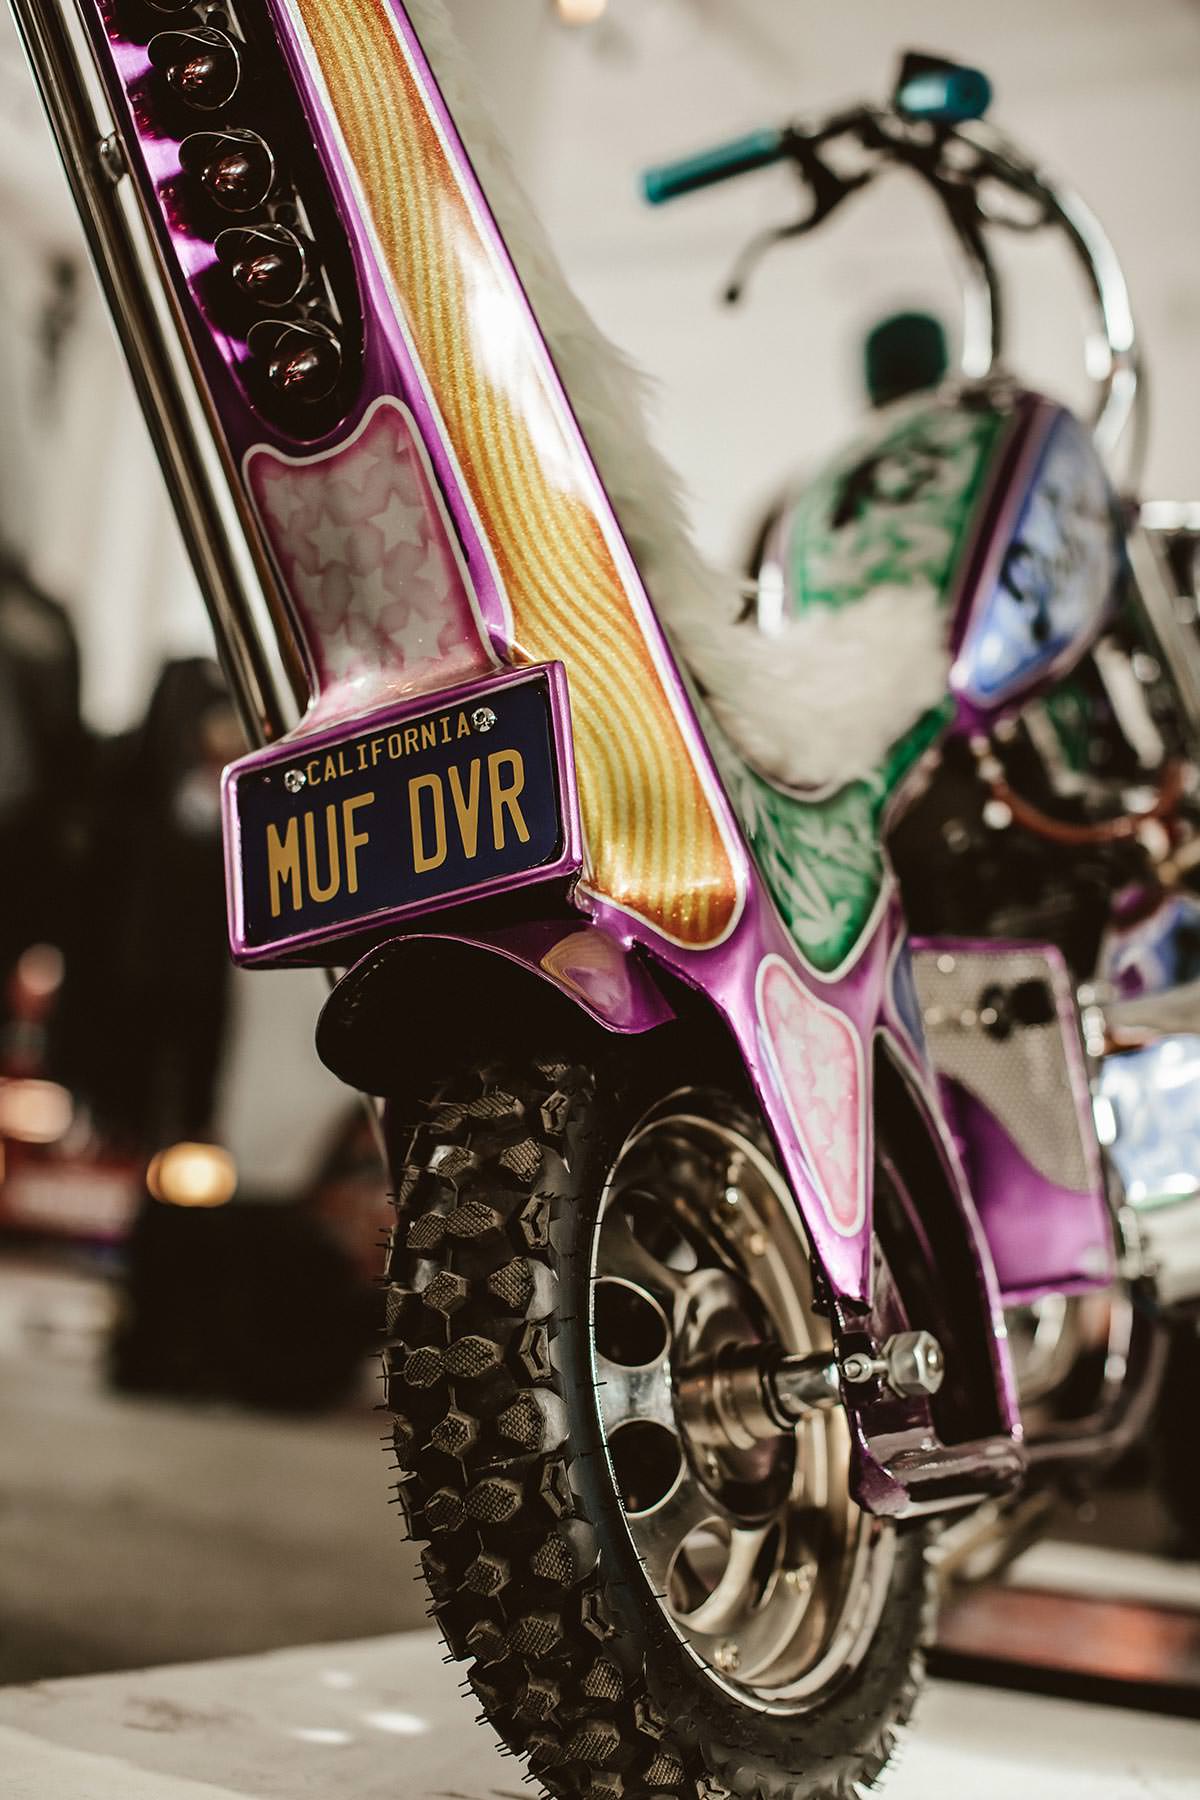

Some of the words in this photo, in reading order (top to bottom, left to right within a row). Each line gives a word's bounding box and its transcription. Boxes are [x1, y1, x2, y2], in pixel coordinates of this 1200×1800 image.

[305, 711, 471, 787] CALIFORNIA
[266, 791, 375, 918] MUF
[408, 748, 530, 874] DVR
